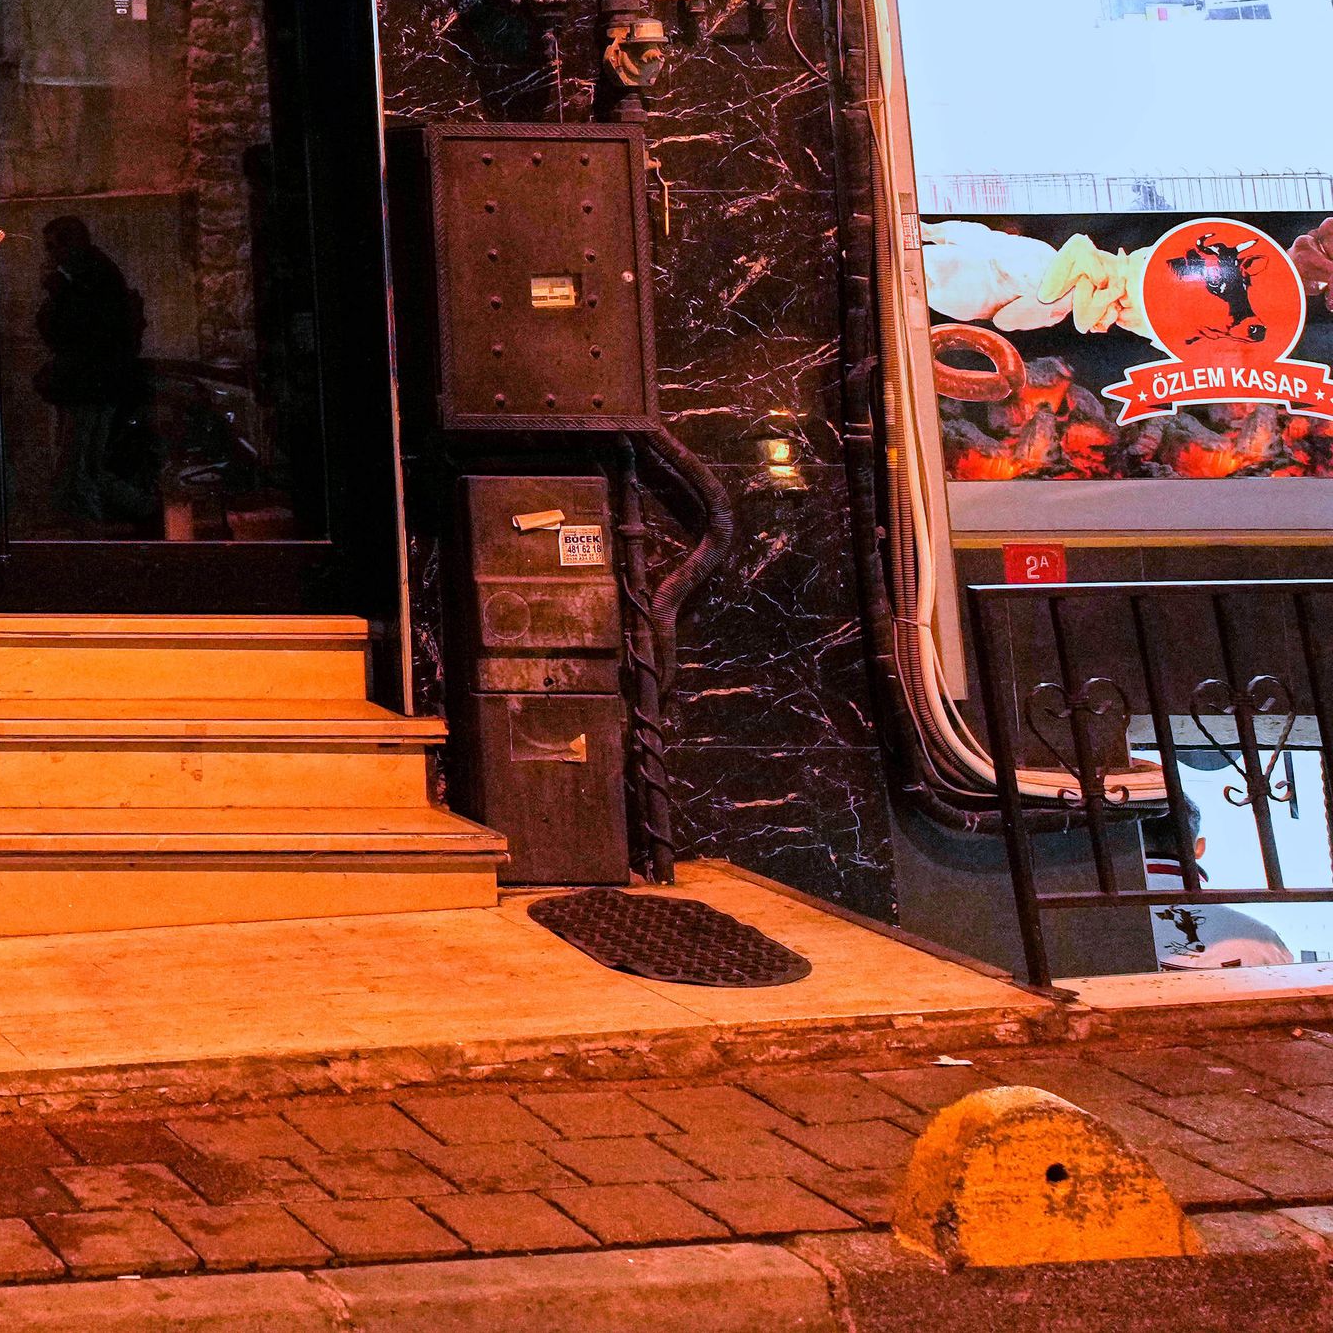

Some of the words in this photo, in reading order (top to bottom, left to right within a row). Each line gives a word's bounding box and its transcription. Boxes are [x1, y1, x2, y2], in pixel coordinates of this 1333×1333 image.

[1152, 367, 1225, 399] ÖZLEM
[1231, 367, 1308, 399] KASAP
[568, 545, 579, 554] 481
[582, 545, 590, 553] 62
[1026, 555, 1049, 579] 2A
